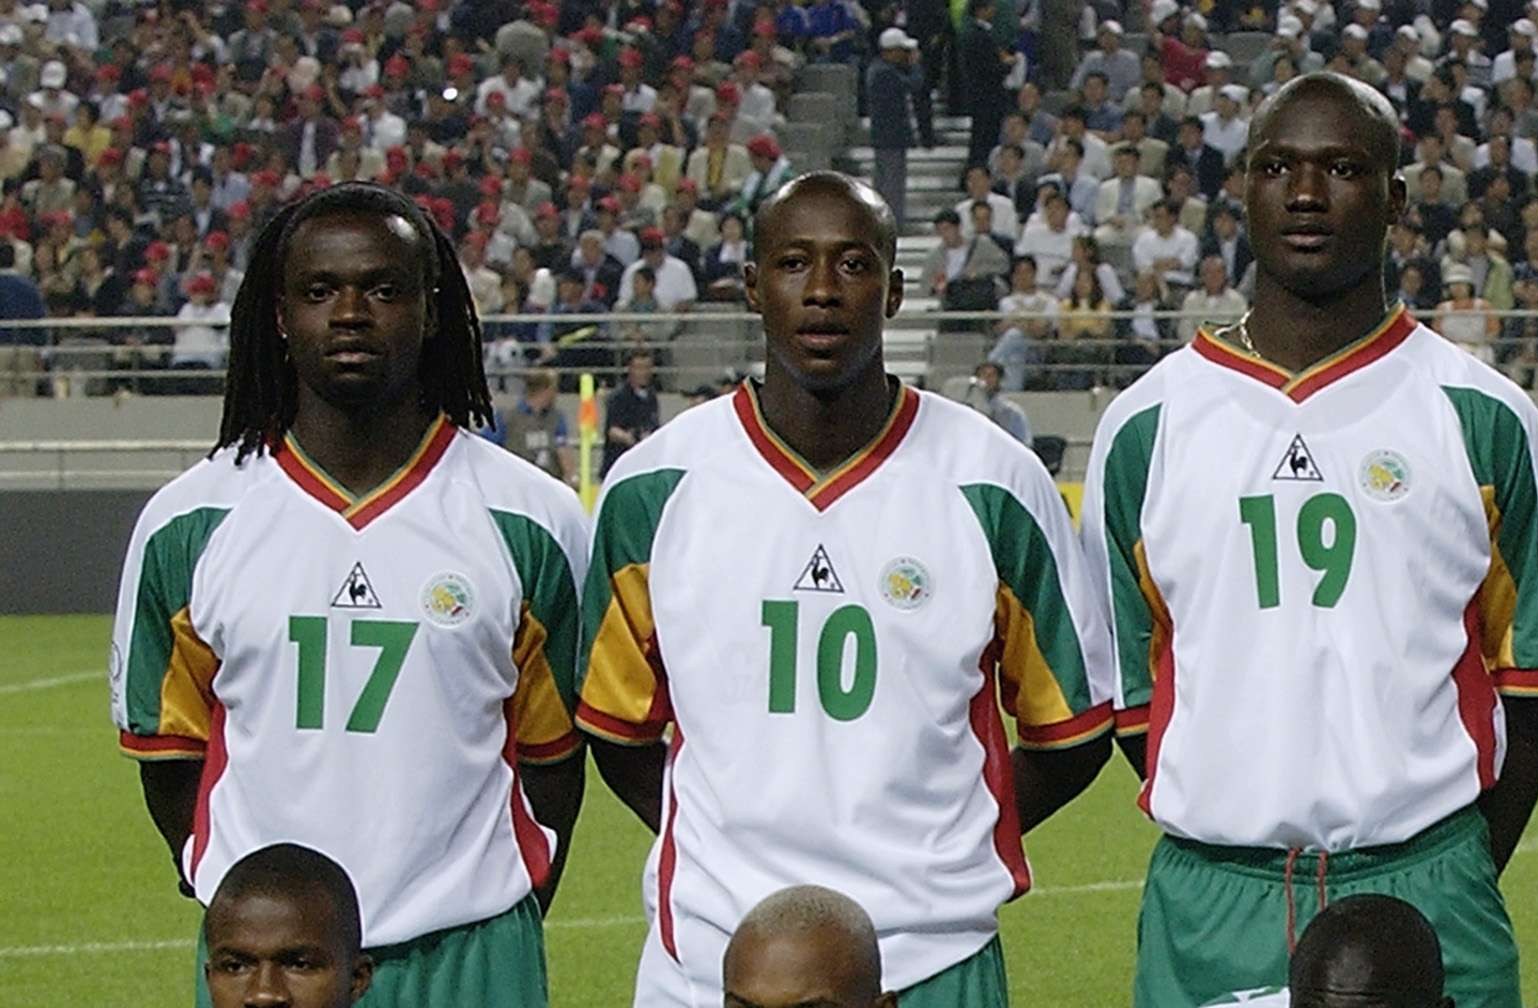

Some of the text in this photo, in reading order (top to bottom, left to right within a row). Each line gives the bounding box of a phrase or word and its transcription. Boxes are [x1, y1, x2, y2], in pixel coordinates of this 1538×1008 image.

[1239, 491, 1357, 609] 19
[287, 615, 418, 734] 17
[761, 599, 877, 721] 10
